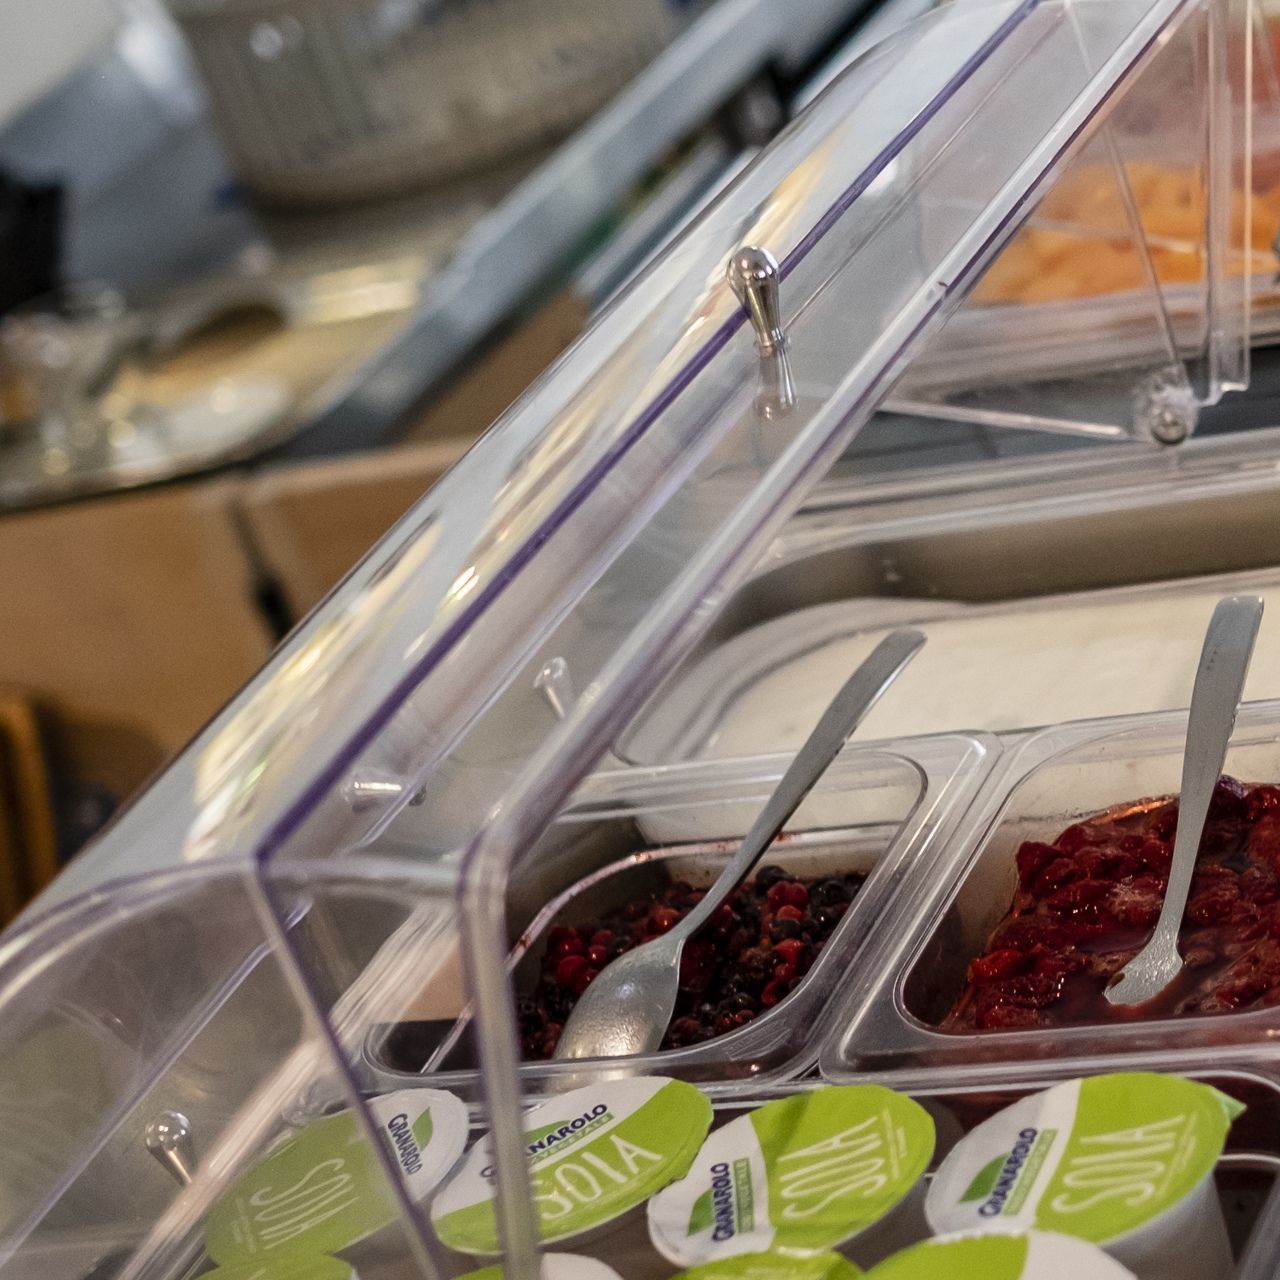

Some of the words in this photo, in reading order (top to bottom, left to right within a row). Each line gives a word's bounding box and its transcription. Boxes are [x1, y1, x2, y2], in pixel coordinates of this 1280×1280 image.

[387, 1112, 424, 1176] GRANAROLO
[776, 1116, 887, 1219] SOIA
[978, 1127, 1038, 1218] GRANAROLO
[1052, 1114, 1186, 1213] SOIA
[250, 1157, 360, 1251] SOIA
[711, 1162, 736, 1242] GRANAROLO
